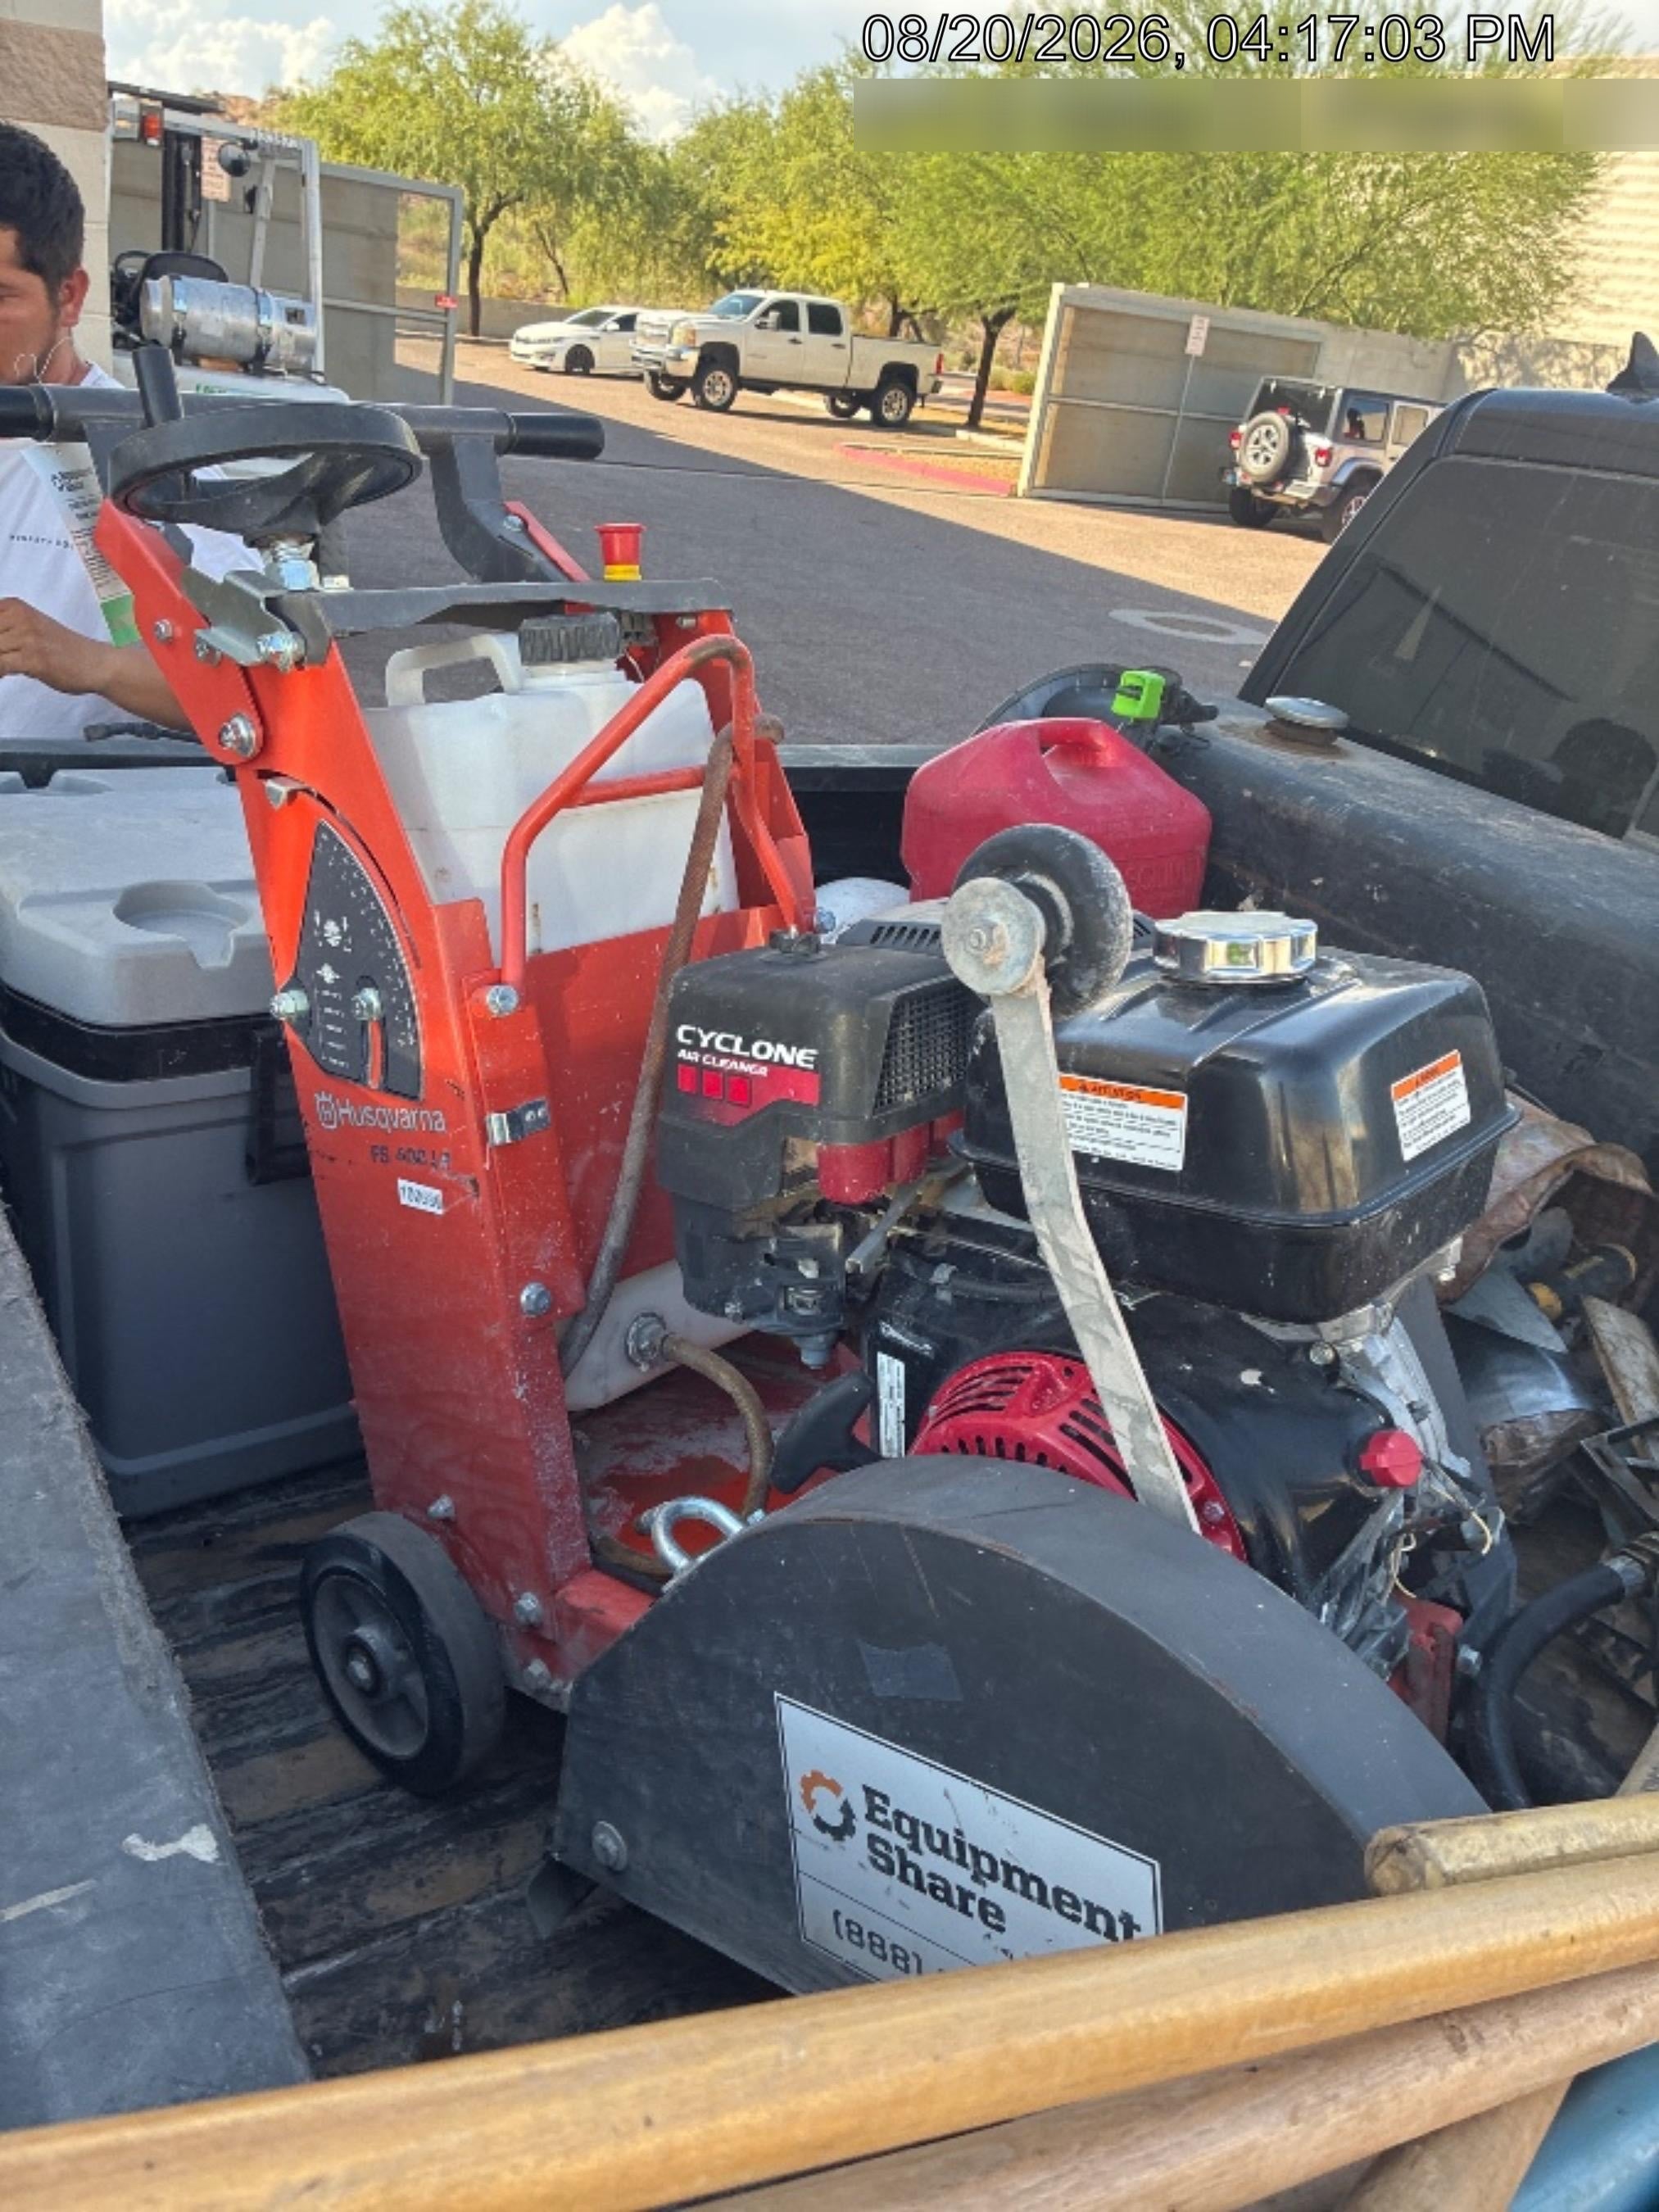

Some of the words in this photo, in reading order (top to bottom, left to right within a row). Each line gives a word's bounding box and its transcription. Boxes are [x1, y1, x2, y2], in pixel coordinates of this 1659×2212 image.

[676, 1024, 818, 1068] CYCLONE
[678, 1049, 700, 1063] AIR
[338, 1098, 446, 1133] Husqvarna
[862, 1784, 1142, 1942] Equipment
[867, 1833, 1007, 1933] Share
